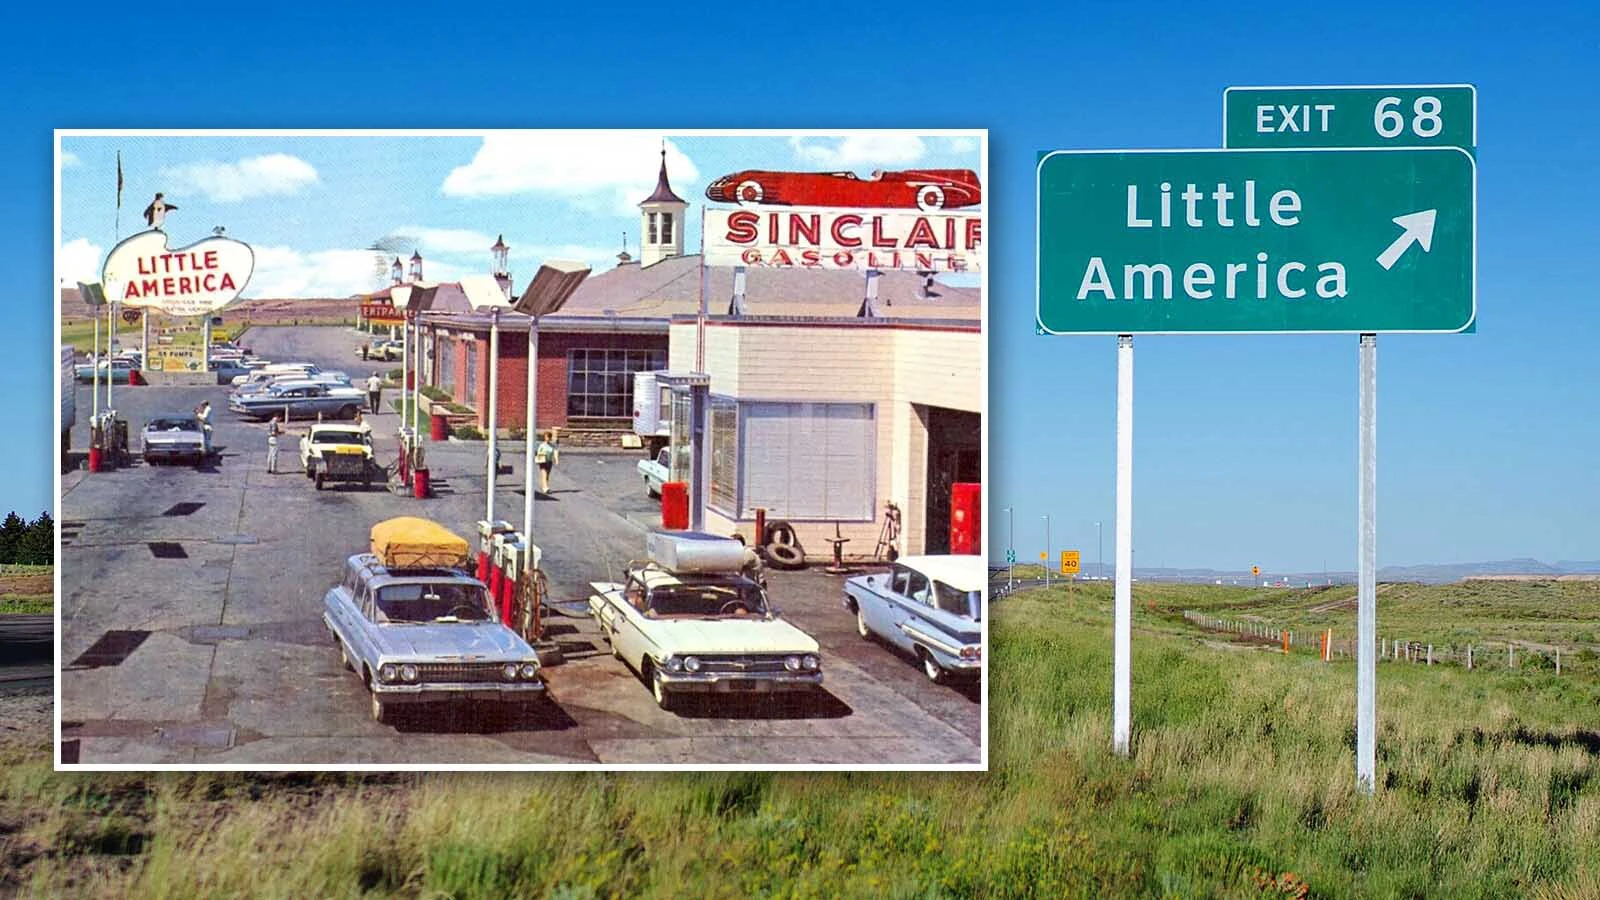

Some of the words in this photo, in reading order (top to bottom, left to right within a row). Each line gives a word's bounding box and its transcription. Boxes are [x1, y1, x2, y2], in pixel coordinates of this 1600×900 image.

[1256, 104, 1335, 133] EXIT
[1373, 96, 1443, 138] 68
[1126, 180, 1302, 228] Little
[137, 251, 218, 275] LITTLE
[741, 249, 968, 270] GASOLINE
[1076, 252, 1349, 300] America
[125, 273, 236, 299] AMERICA
